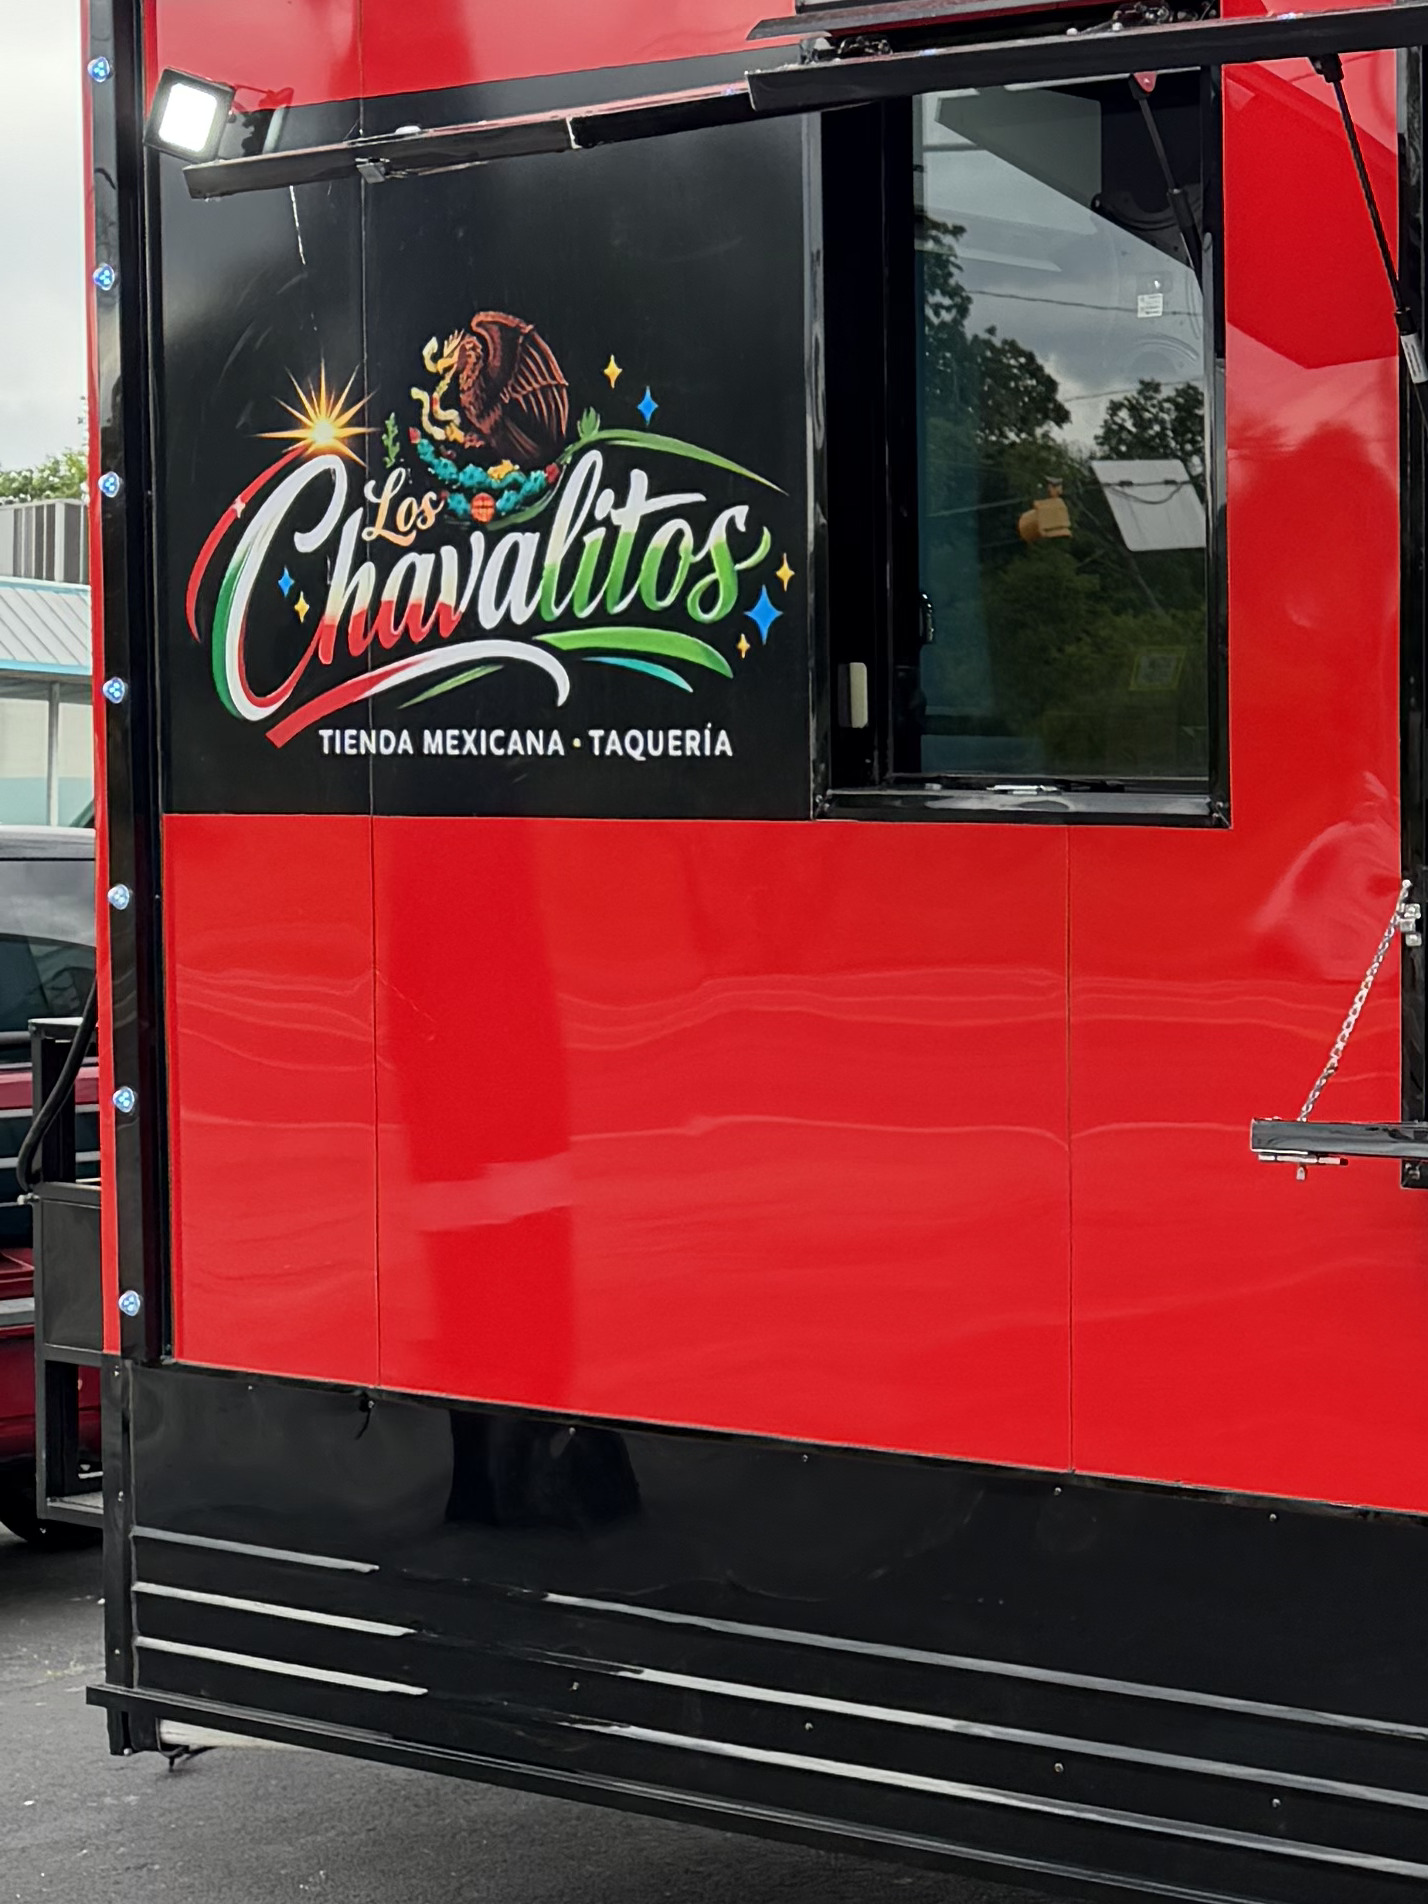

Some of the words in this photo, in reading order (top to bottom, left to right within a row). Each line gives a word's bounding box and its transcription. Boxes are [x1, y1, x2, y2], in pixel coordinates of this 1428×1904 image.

[363, 467, 445, 546] Los
[211, 449, 772, 722] Chavalitos
[319, 728, 413, 756] TIENDA
[423, 728, 565, 757] MEXICANA
[588, 721, 733, 761] TAQUERÍA
